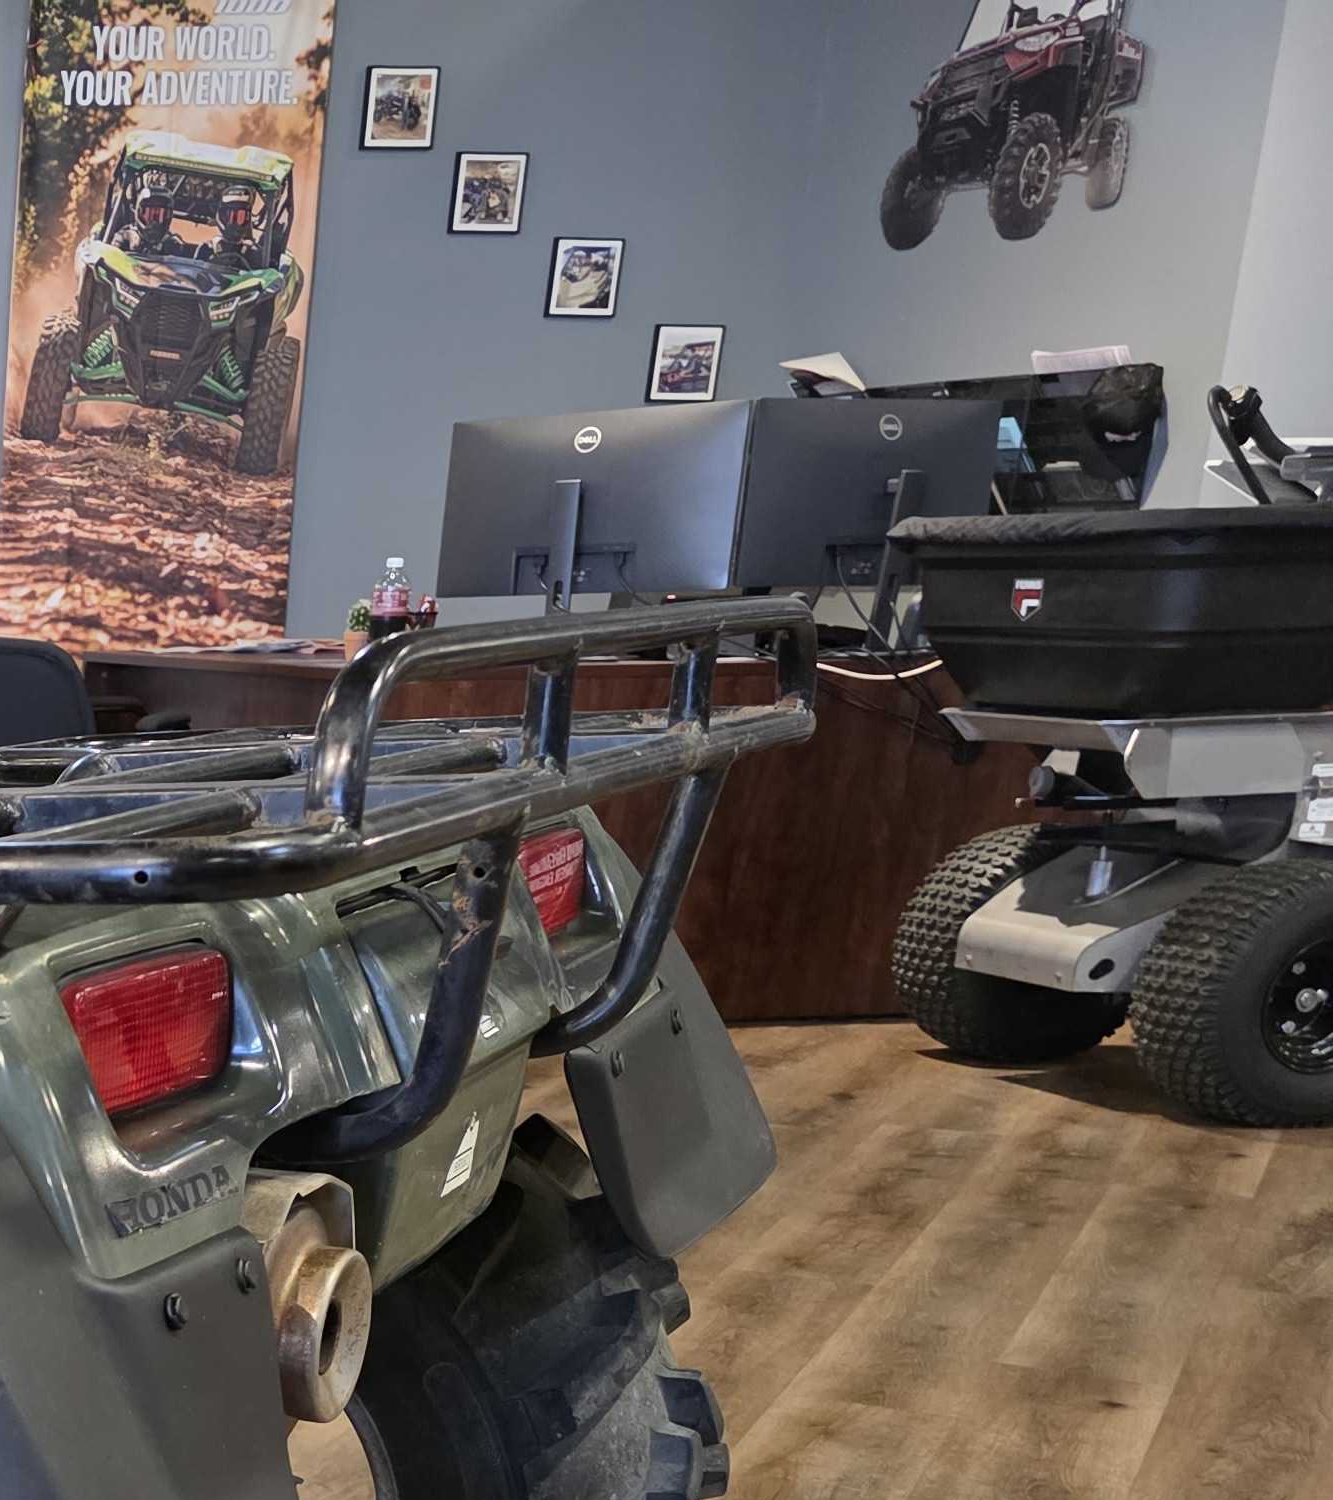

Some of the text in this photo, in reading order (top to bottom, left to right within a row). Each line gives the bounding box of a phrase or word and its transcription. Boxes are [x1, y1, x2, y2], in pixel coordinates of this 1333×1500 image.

[92, 24, 276, 61] YOUR WORLD.
[60, 69, 298, 106] YOUR ADVENTURE.
